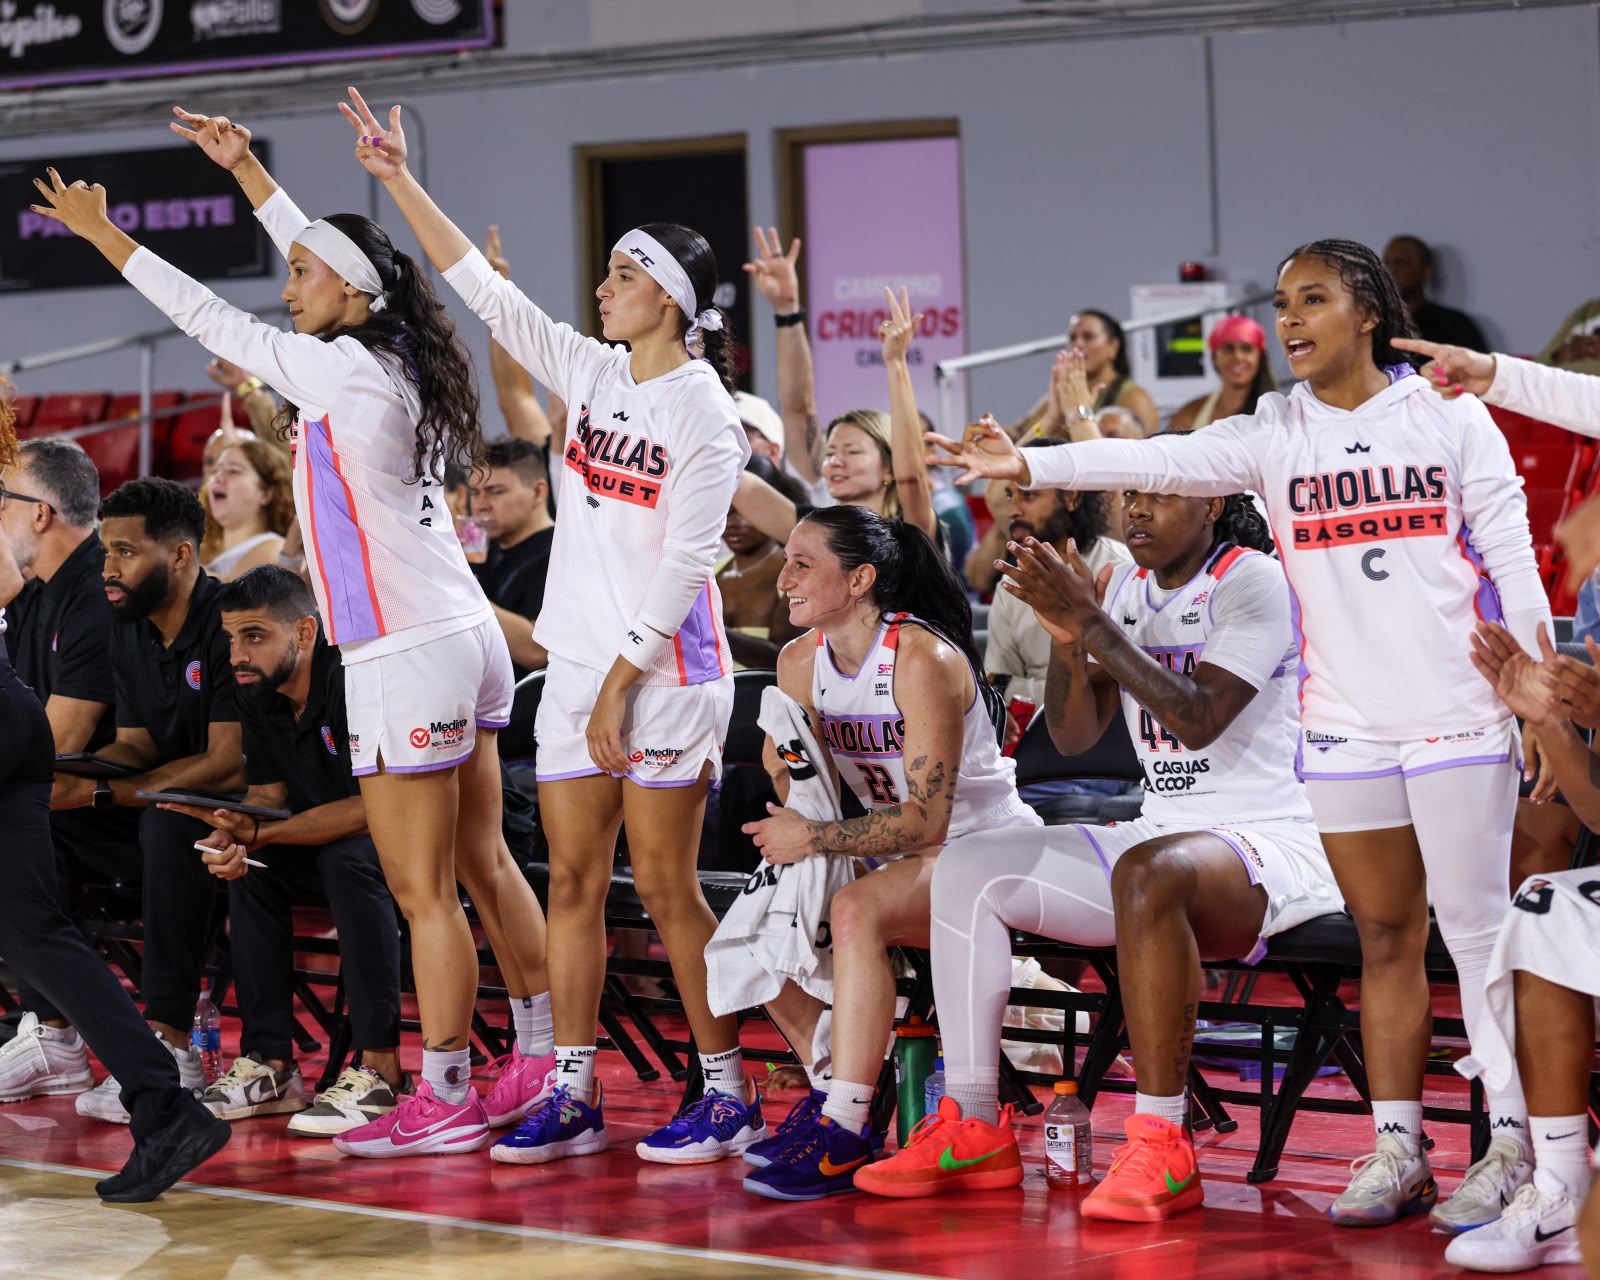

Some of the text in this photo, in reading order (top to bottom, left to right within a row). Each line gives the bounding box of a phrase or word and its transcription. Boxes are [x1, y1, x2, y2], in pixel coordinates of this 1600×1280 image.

[17, 195, 234, 240] PAO ESTE
[817, 305, 960, 342] CRIOOS
[1288, 464, 1447, 516] CRIOLLAS
[1295, 514, 1444, 543] BASQUET
[645, 748, 684, 757] Medina
[1153, 758, 1210, 775] CAGUAS
[853, 762, 901, 807] 22
[1155, 776, 1197, 792] COOP
[1046, 1126, 1059, 1140] G
[1047, 1140, 1072, 1148] GATORLYTE
